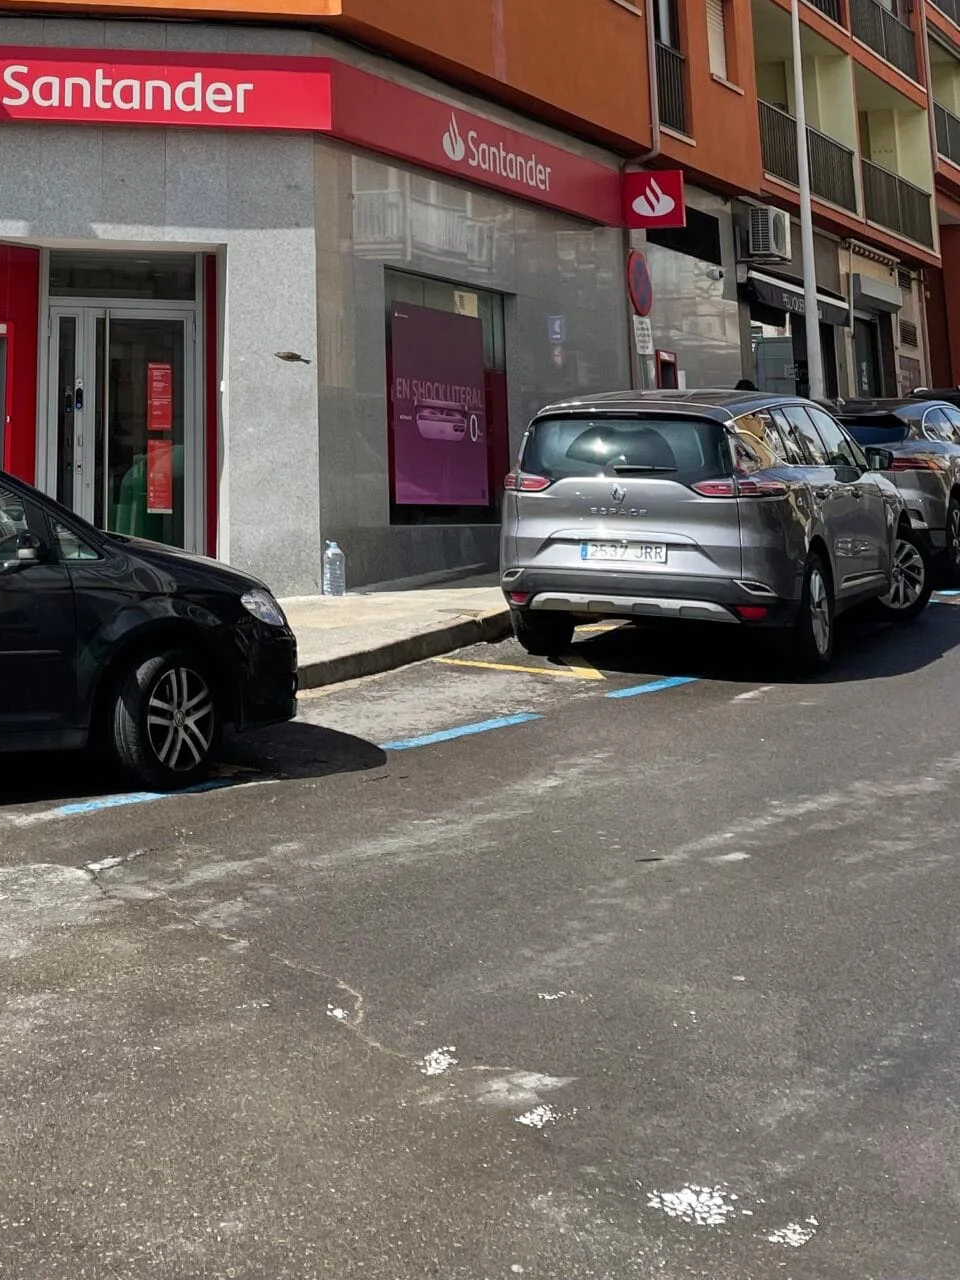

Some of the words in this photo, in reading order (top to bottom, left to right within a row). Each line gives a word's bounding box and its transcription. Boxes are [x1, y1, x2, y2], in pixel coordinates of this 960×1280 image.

[2, 65, 254, 114] Santander
[467, 130, 552, 191] Santander
[396, 377, 410, 399] EN
[412, 380, 445, 402] SHOCK
[446, 383, 483, 408] LITERAL
[590, 544, 628, 558] 2537
[634, 545, 664, 560] JRR
